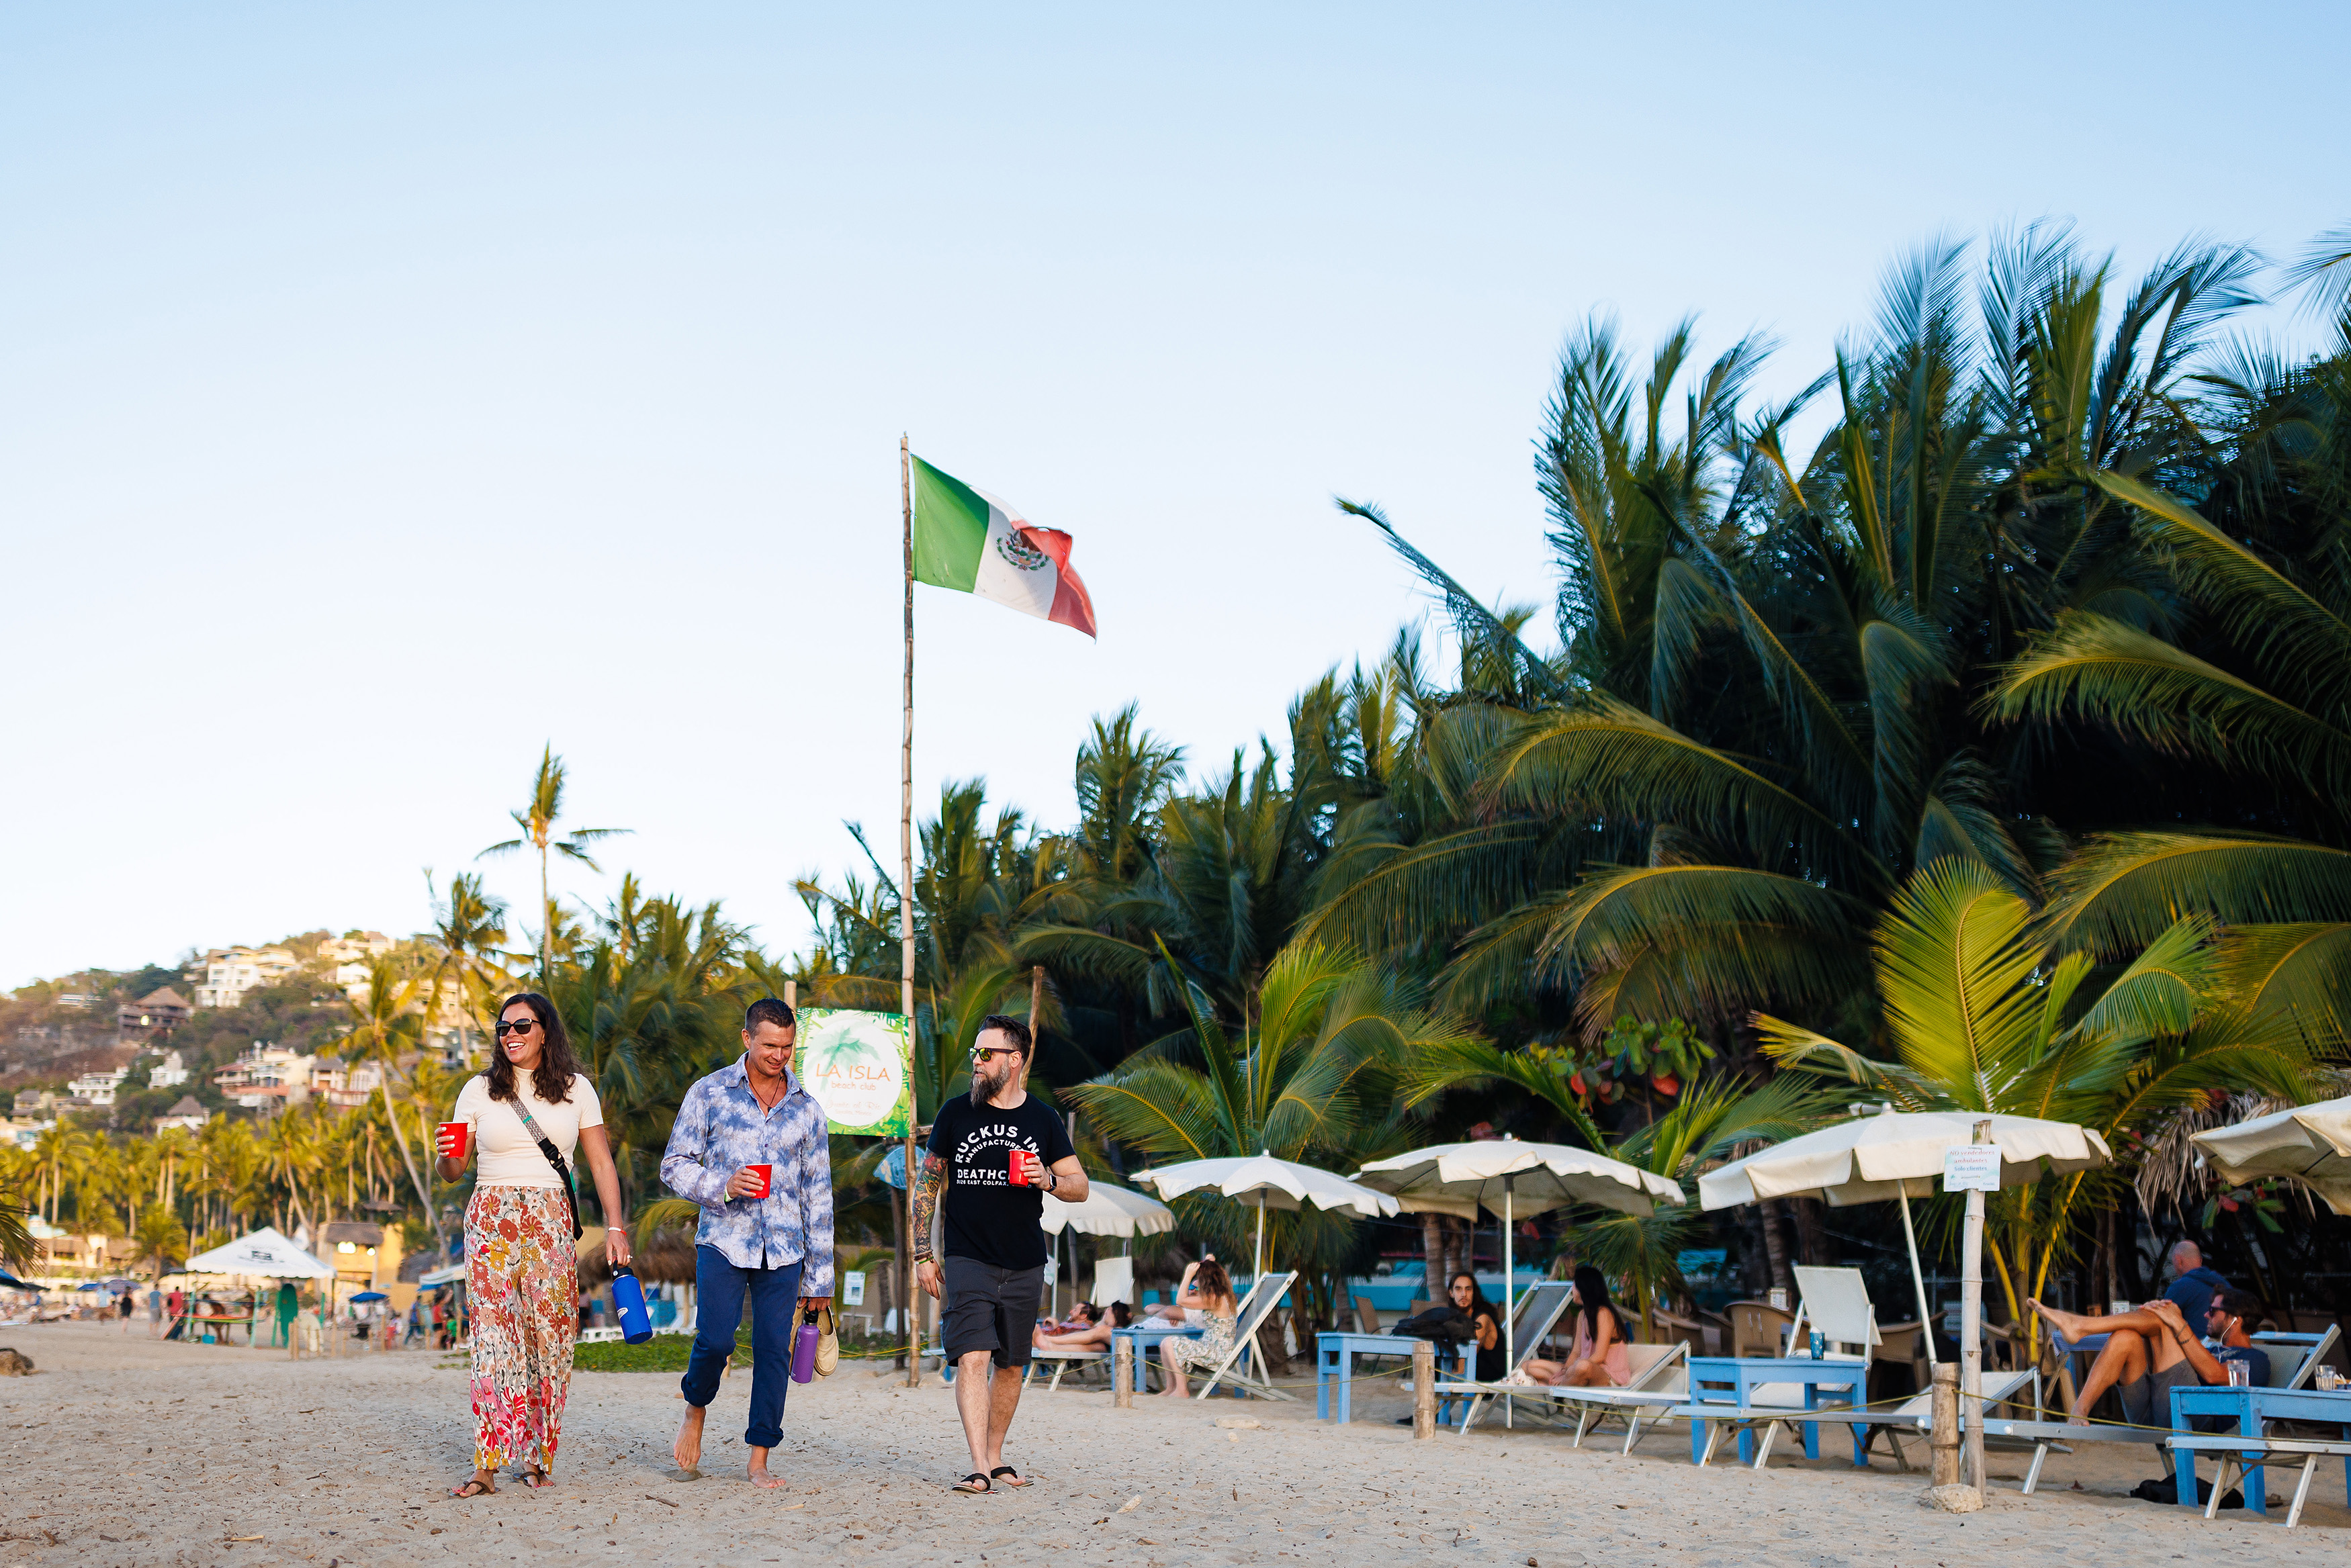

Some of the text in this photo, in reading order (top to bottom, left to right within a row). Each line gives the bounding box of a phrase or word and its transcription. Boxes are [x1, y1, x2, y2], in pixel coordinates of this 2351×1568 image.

[816, 1063, 891, 1082] LA ISLA
[831, 1080, 877, 1091] beach club
[955, 1124, 1040, 1163] RUCKUS IN
[965, 1139, 1024, 1163] MANUFACTURE
[957, 1168, 1010, 1180] DEATHC
